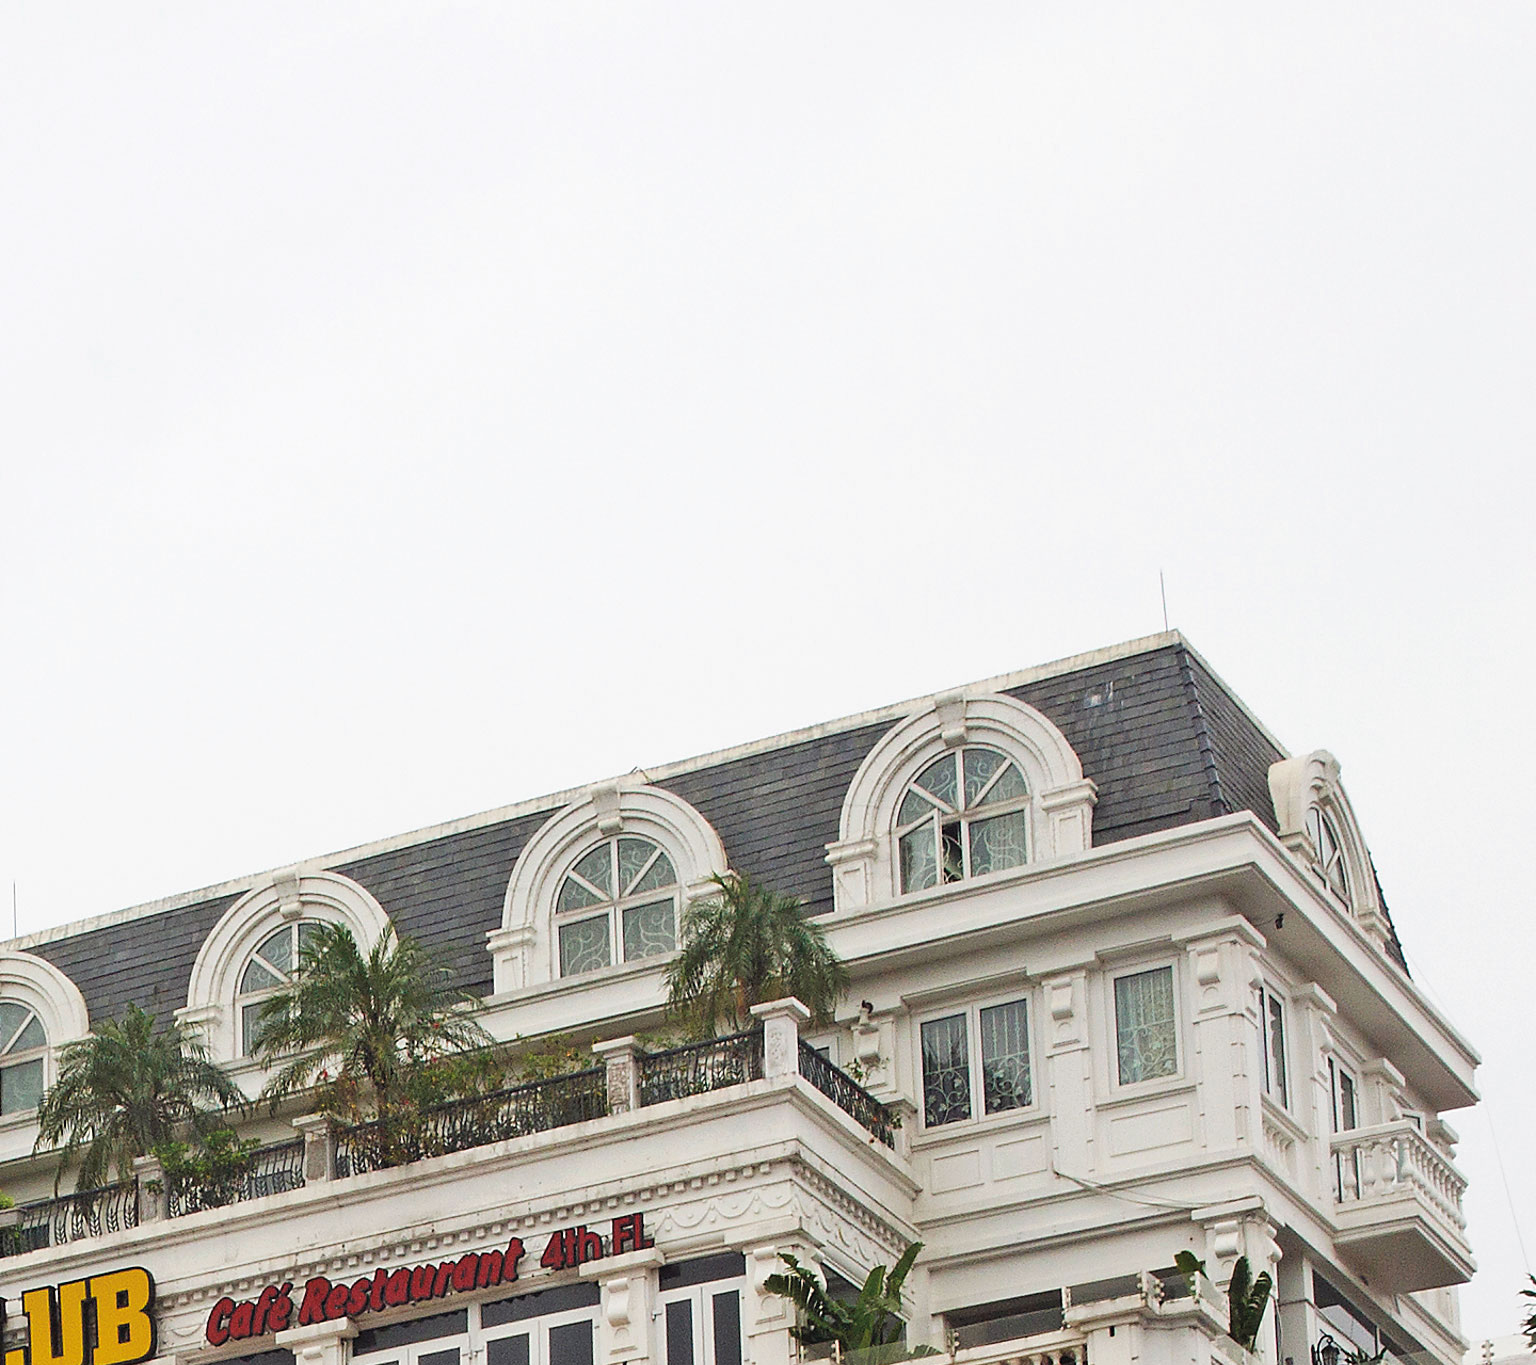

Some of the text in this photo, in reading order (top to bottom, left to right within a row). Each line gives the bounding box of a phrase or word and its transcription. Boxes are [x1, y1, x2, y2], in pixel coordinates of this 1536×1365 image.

[206, 1211, 655, 1347] Café Restaurant 4th FL
